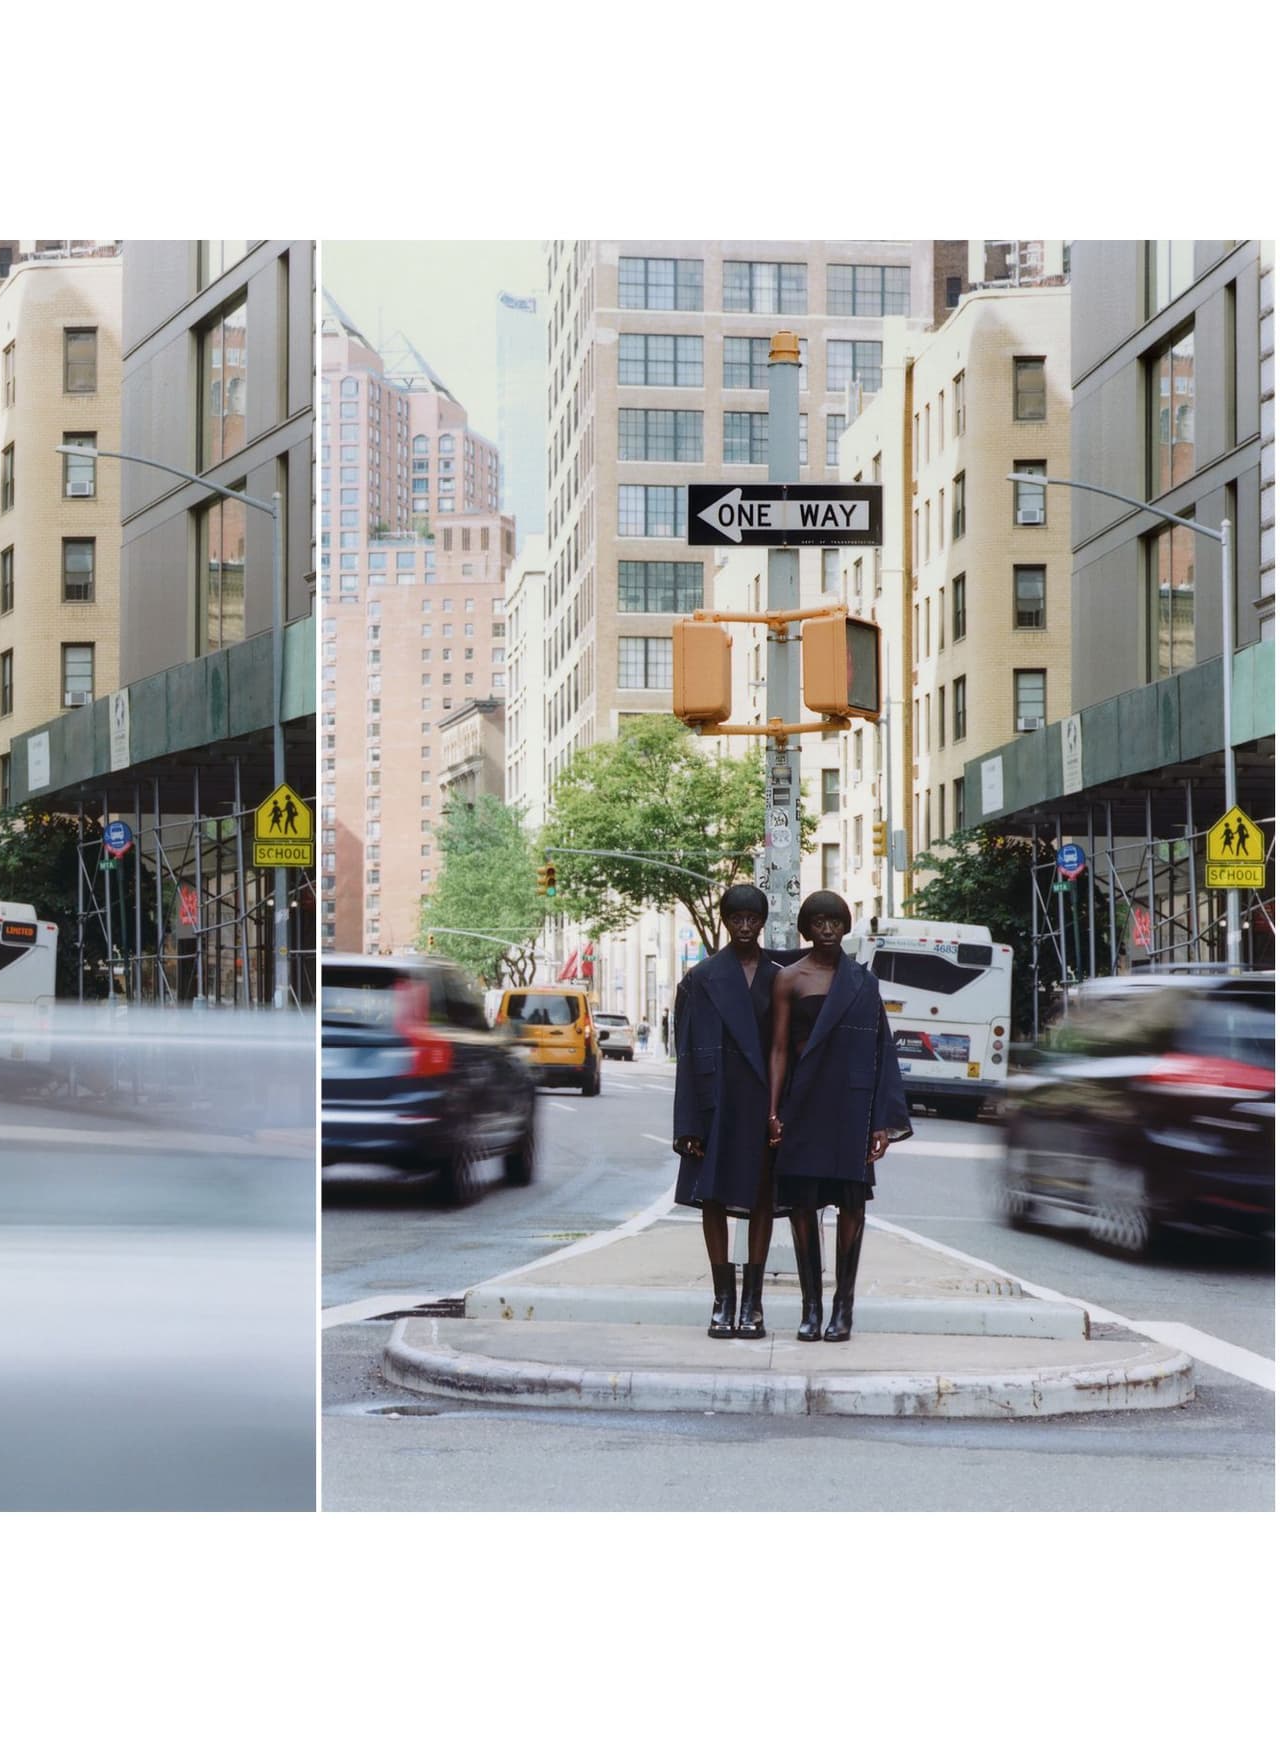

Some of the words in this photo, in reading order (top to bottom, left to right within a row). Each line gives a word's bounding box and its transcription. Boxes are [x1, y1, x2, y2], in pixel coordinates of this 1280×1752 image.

[718, 503, 772, 527] ONE
[799, 503, 857, 527] WAY
[258, 848, 308, 860] SCHOOL
[1210, 869, 1258, 881] SCHOOL
[5, 926, 34, 937] LIMITED
[934, 944, 958, 954] 4683
